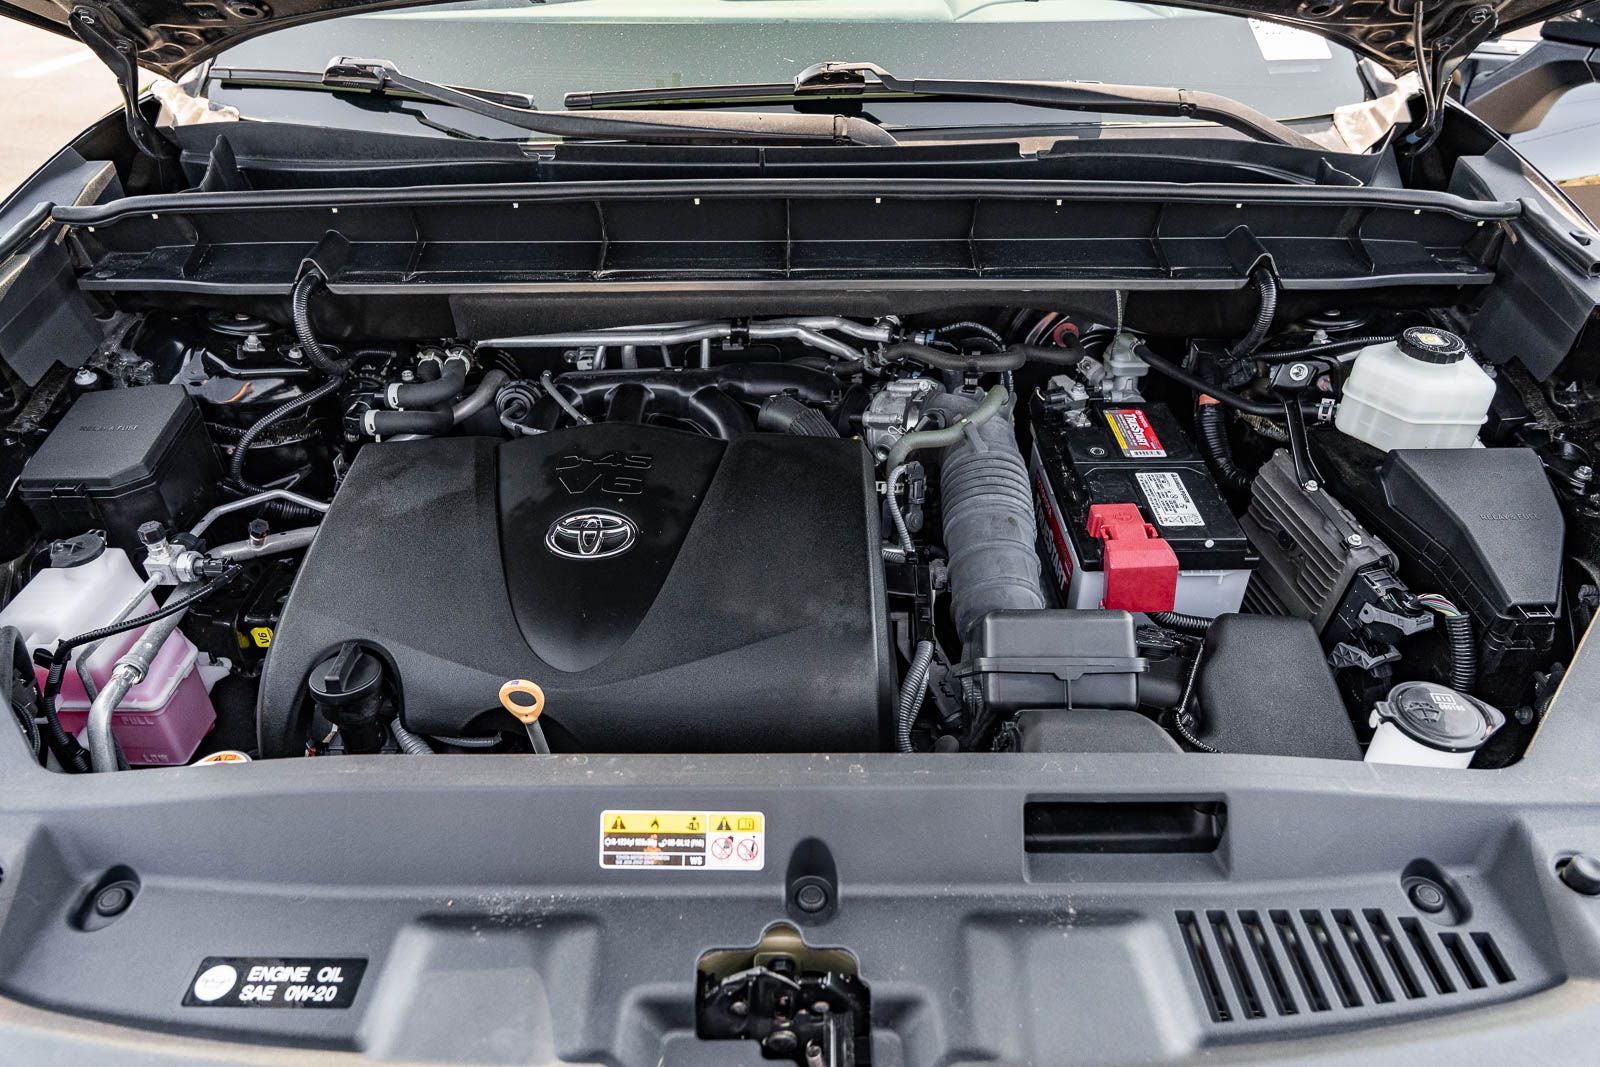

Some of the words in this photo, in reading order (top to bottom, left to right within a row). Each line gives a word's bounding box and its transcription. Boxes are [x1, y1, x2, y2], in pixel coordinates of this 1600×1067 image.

[257, 632, 270, 644] V6
[121, 716, 154, 726] FULL
[246, 966, 312, 983] ENGINE
[316, 966, 345, 983] OIL
[238, 984, 278, 1002] SAE
[283, 985, 338, 1003] 0W-20
